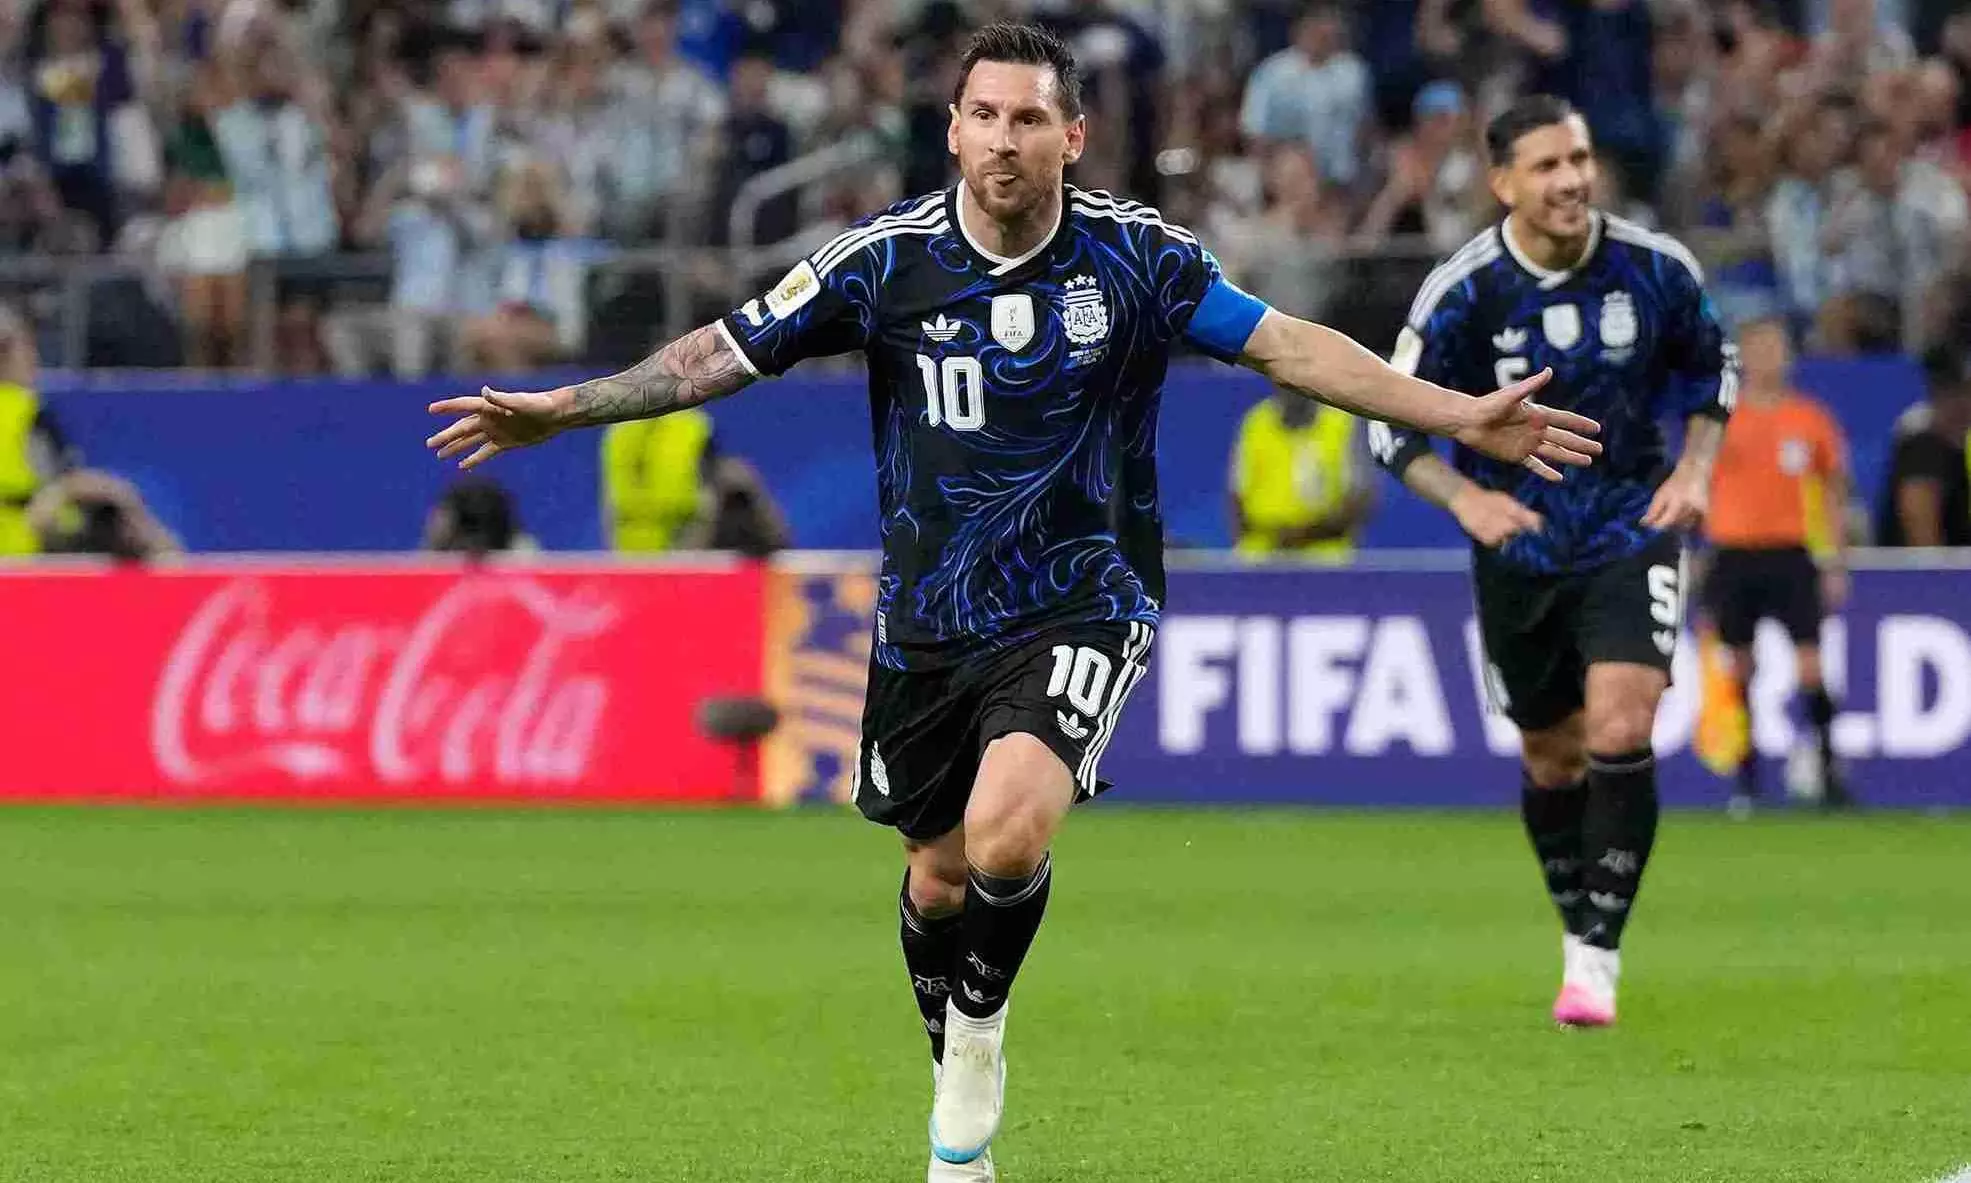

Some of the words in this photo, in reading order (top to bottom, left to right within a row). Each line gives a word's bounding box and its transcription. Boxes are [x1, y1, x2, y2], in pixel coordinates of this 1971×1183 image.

[917, 354, 987, 432] 10
[1647, 564, 1678, 625] 5
[1046, 644, 1112, 717] 10
[1157, 614, 1456, 757] FIFA
